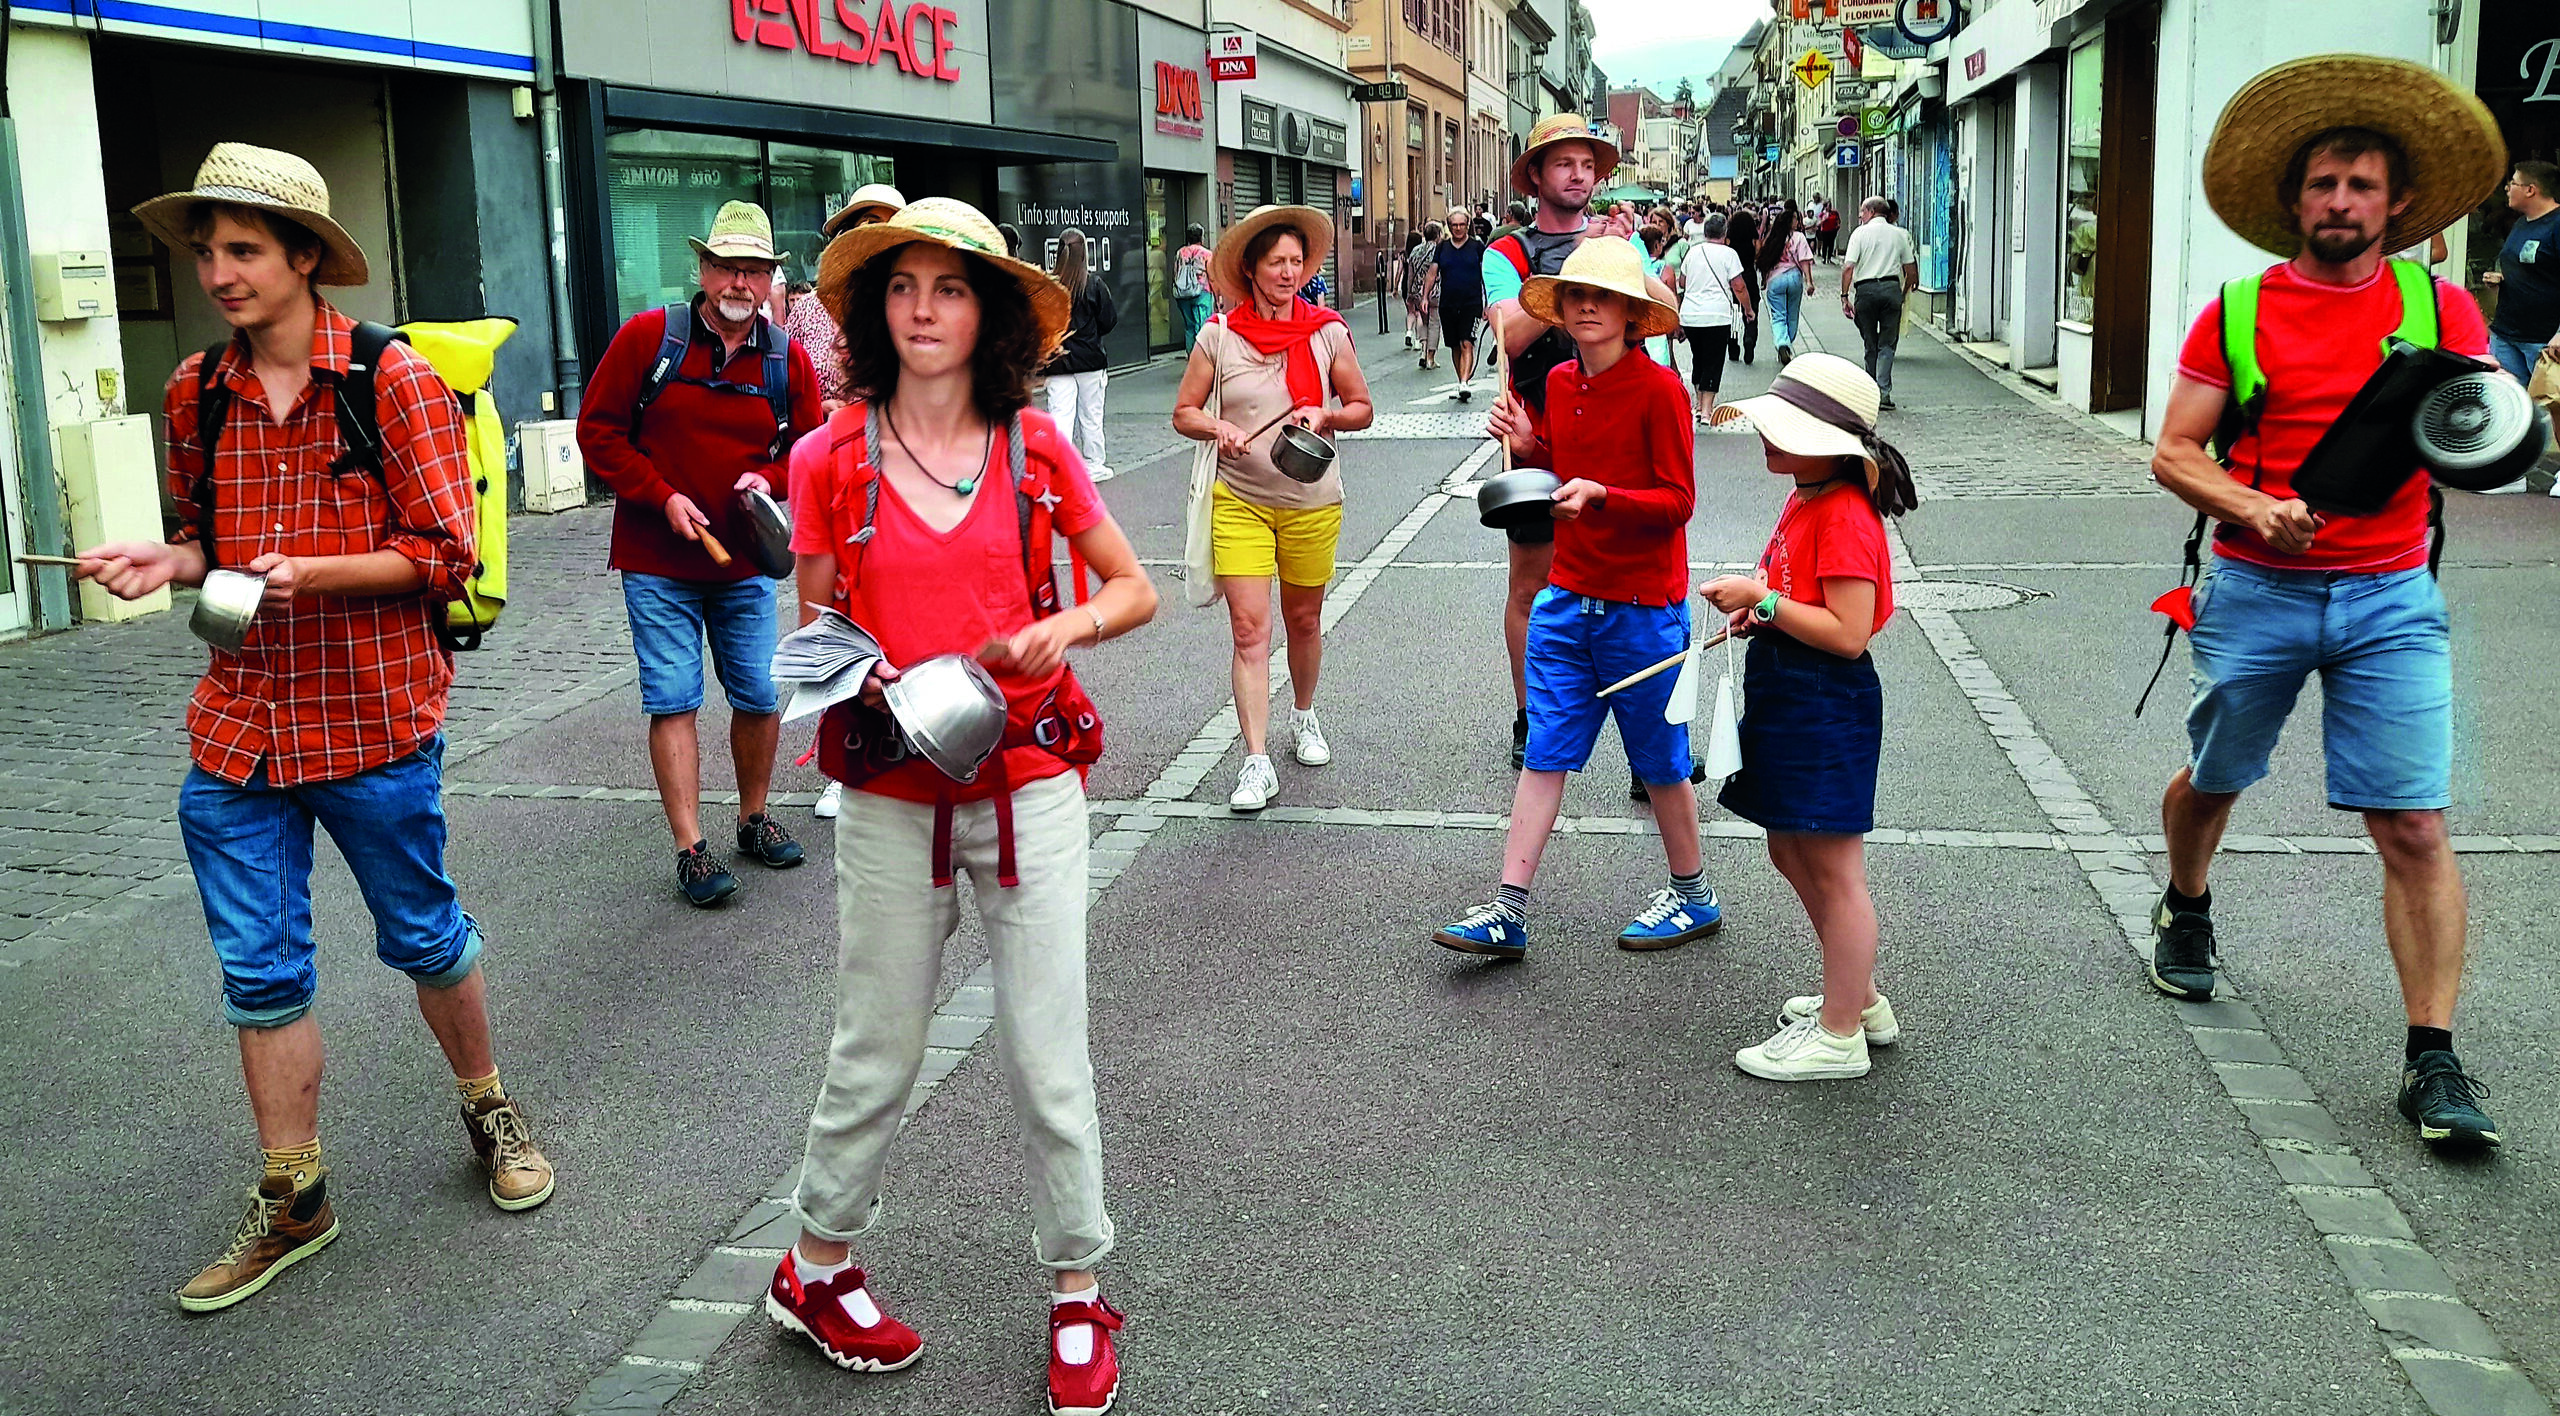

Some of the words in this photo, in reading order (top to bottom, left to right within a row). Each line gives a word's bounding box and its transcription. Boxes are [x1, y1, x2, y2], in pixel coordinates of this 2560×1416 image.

[1846, 8, 1891, 21] FLORIVAL
[1218, 60, 1247, 74] DNA
[1155, 61, 1204, 119] DNA
[1017, 202, 1042, 225] L'info
[1044, 207, 1059, 226] sur
[1060, 204, 1080, 226] tous
[1080, 203, 1093, 226] les
[1094, 207, 1130, 231] supports
[1781, 562, 1792, 600] HAPP
